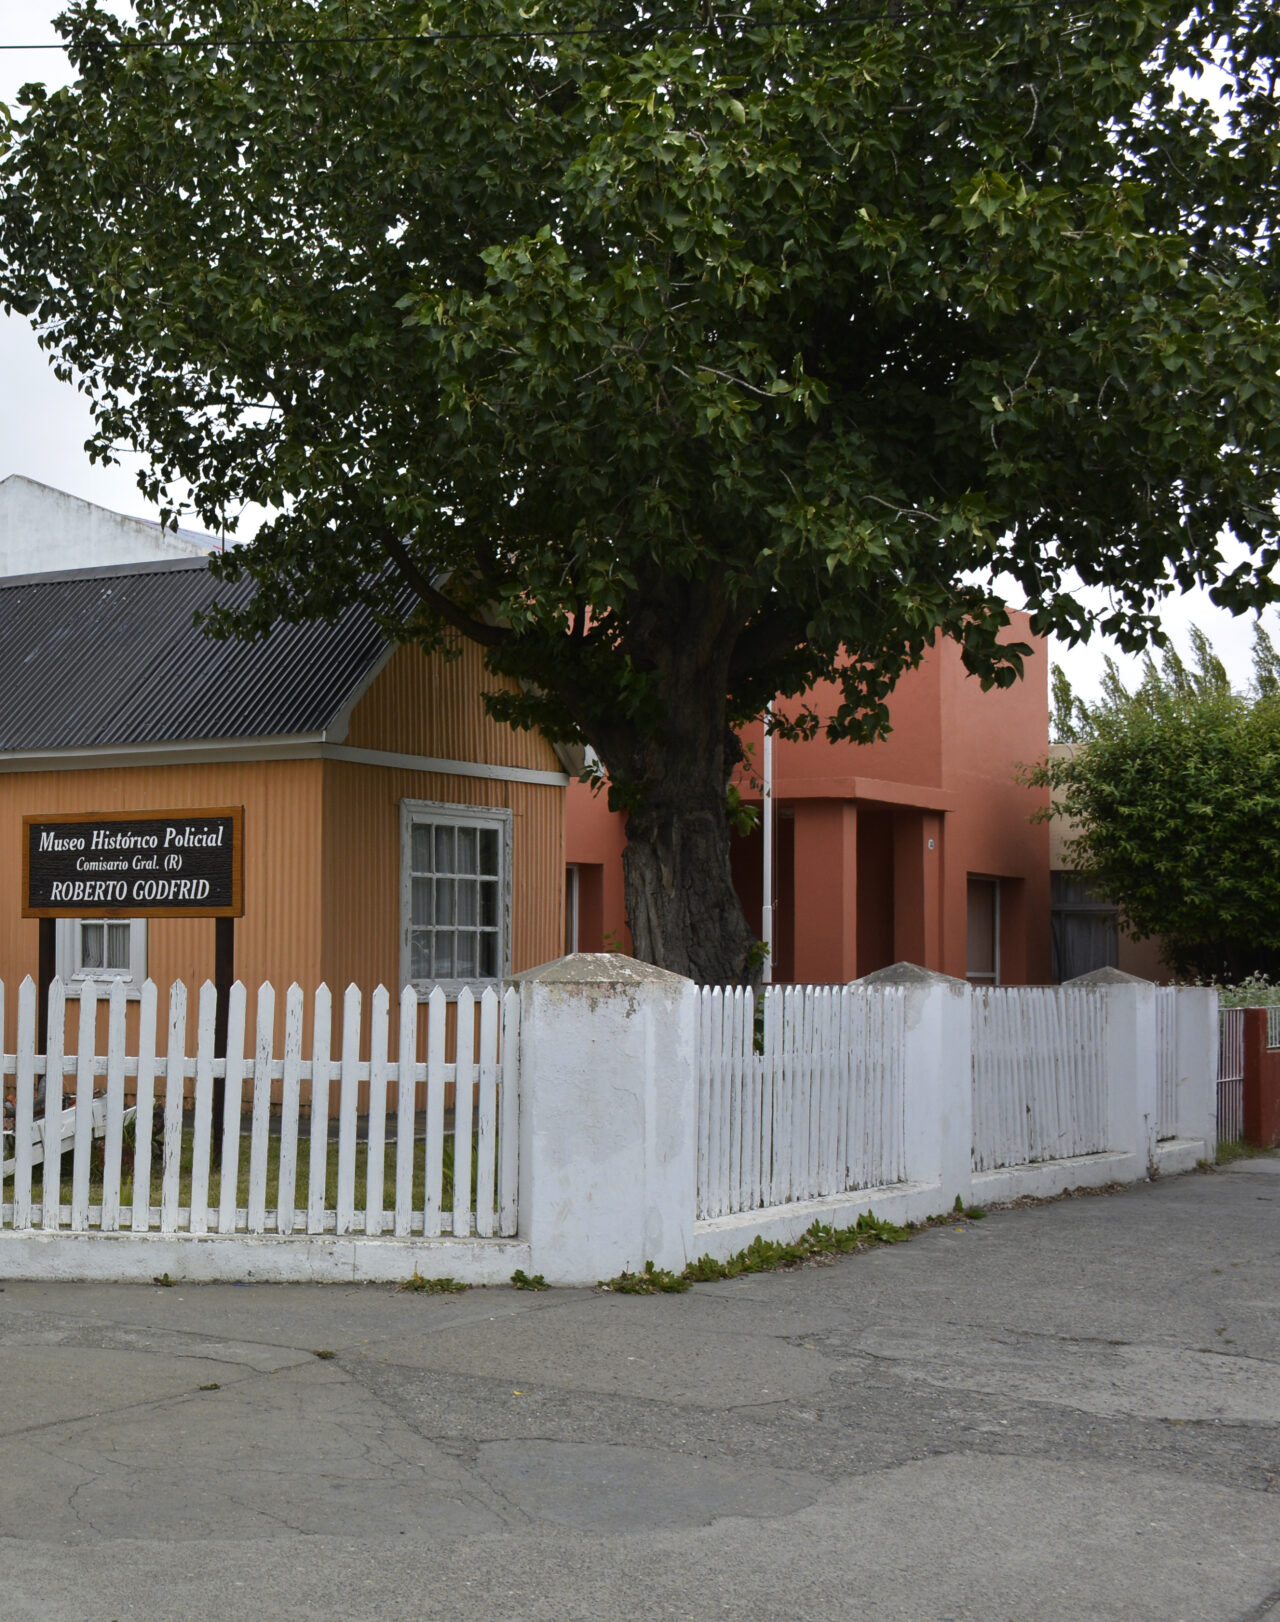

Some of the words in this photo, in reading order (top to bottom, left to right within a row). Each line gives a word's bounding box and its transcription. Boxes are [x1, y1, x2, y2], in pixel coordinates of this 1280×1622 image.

[39, 831, 85, 852] Museo
[163, 825, 224, 848] Policial
[76, 856, 129, 871] Comisario
[132, 854, 160, 870] Gral.
[164, 854, 183, 872] (R)
[50, 880, 128, 901] ROBERTO
[132, 879, 210, 900] GODFRID
